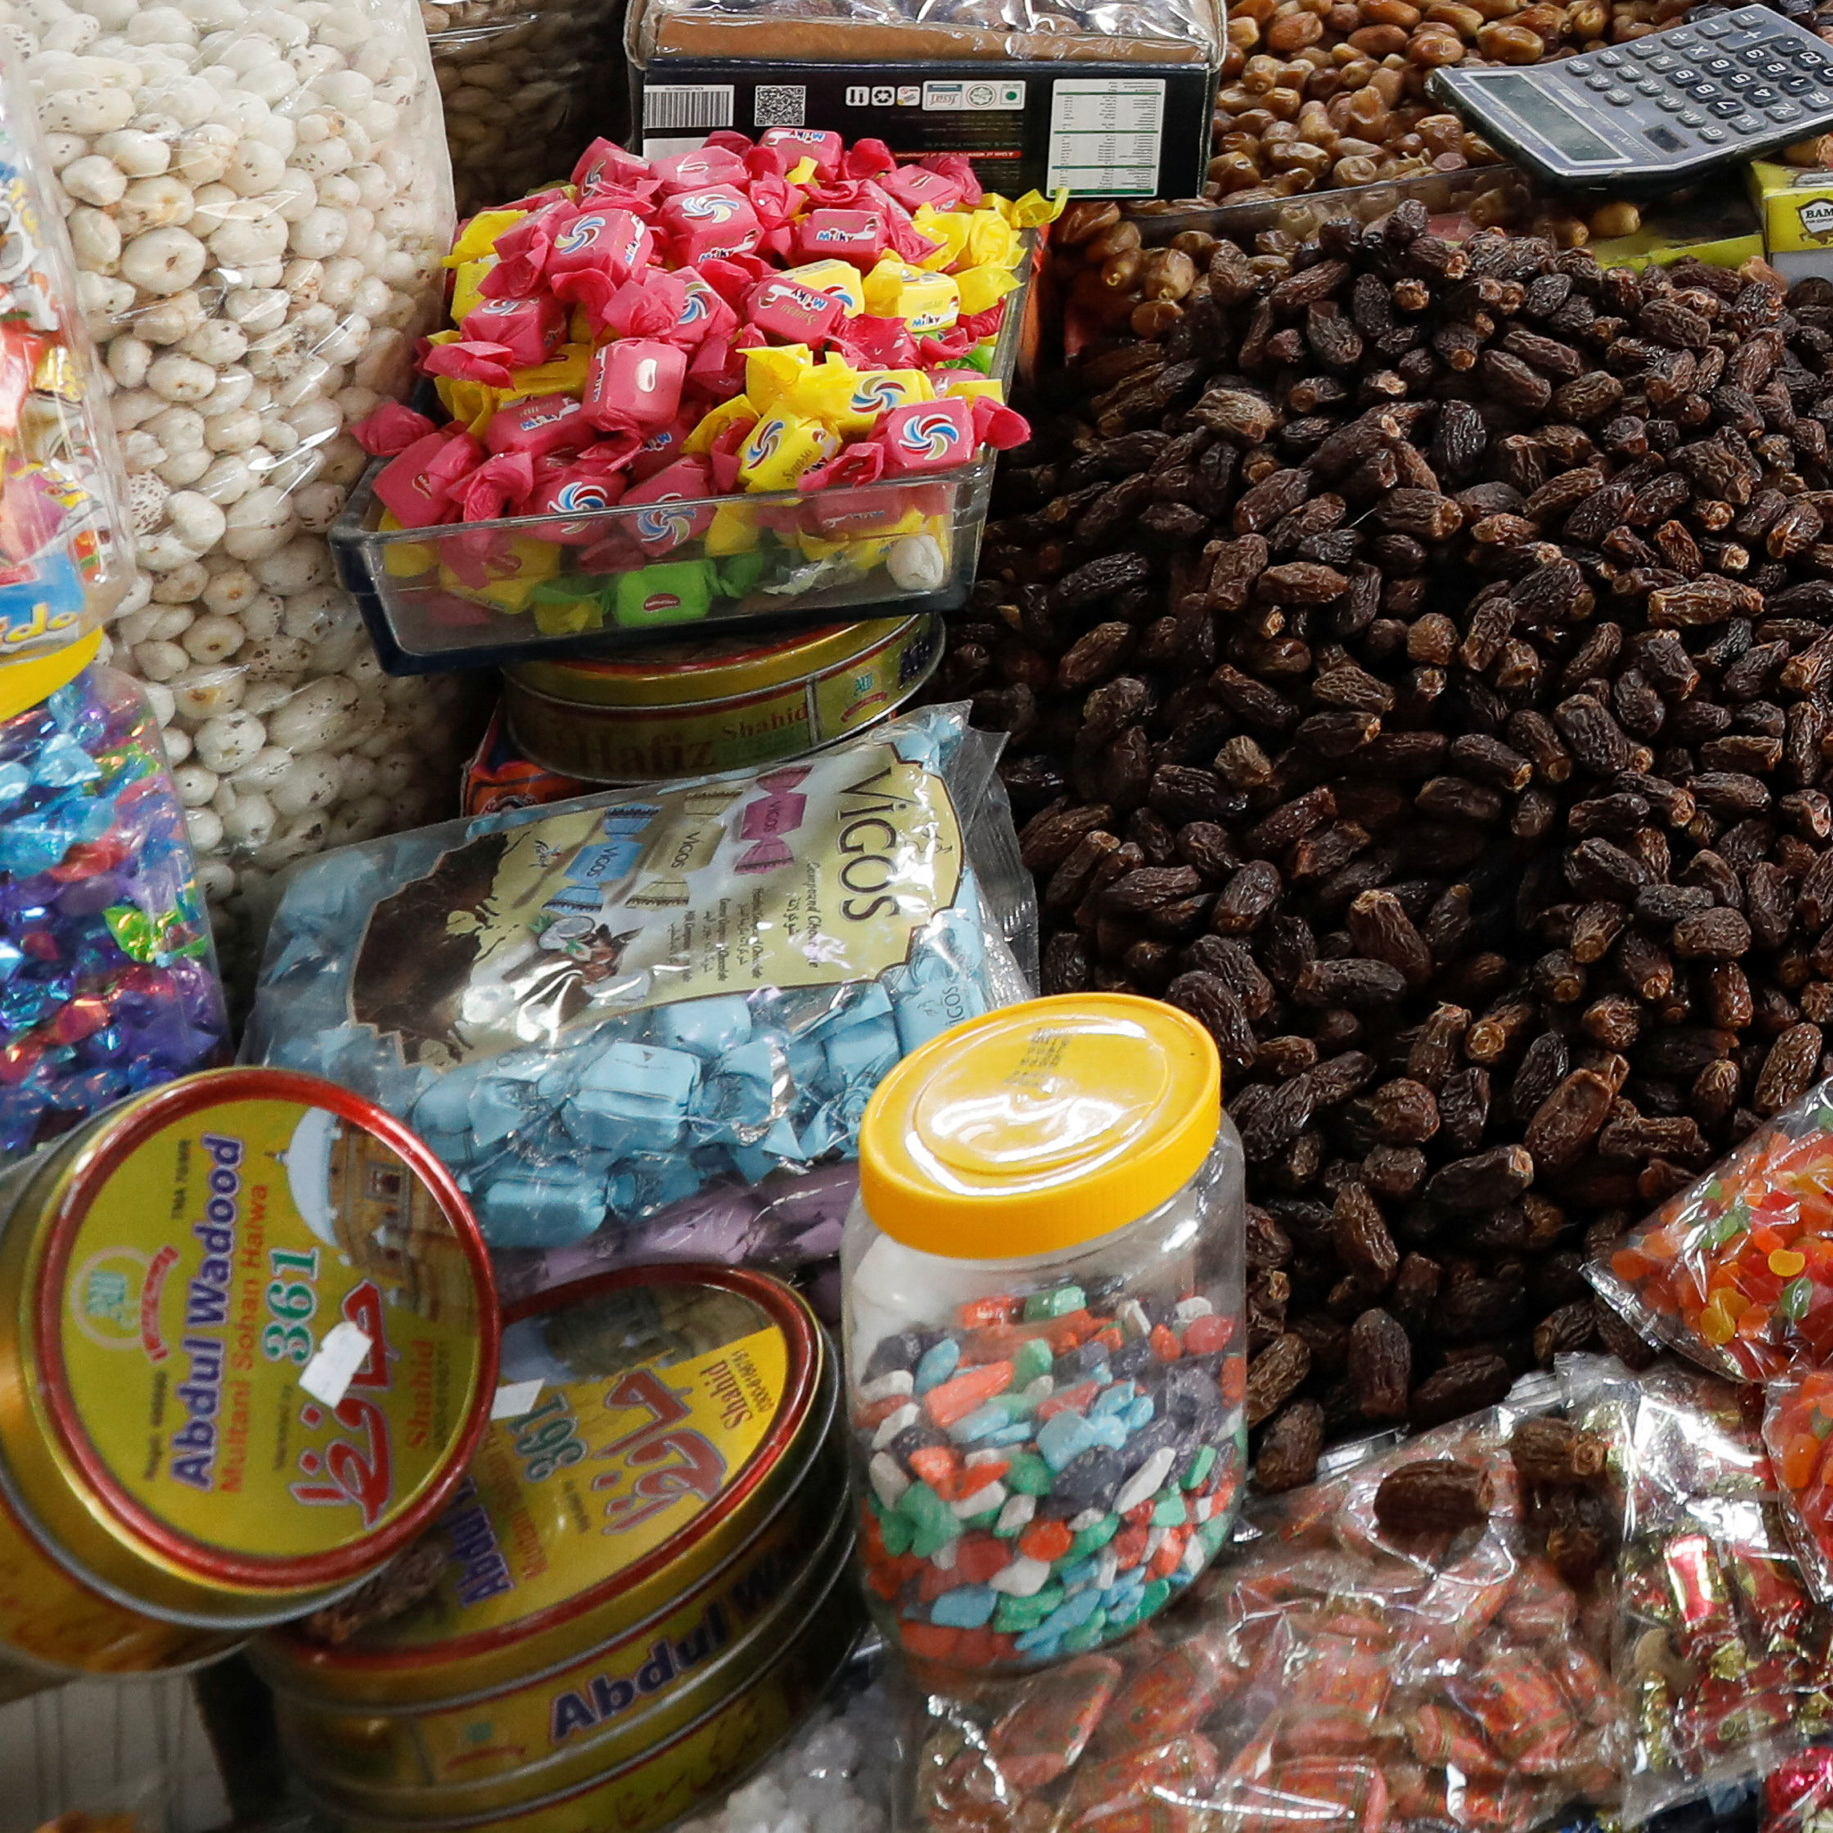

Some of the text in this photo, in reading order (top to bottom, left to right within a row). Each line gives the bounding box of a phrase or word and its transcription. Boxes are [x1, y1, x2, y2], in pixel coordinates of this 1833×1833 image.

[816, 230, 854, 243] Milky
[791, 288, 828, 311] Milky
[912, 314, 940, 326] Milky
[169, 1133, 245, 1492] Abdul Wadood
[262, 1245, 319, 1363] 361
[407, 1339, 434, 1450] Shahid
[506, 1391, 588, 1484] 361
[700, 1358, 754, 1432] Shahid
[548, 1605, 731, 1744] Abdul
